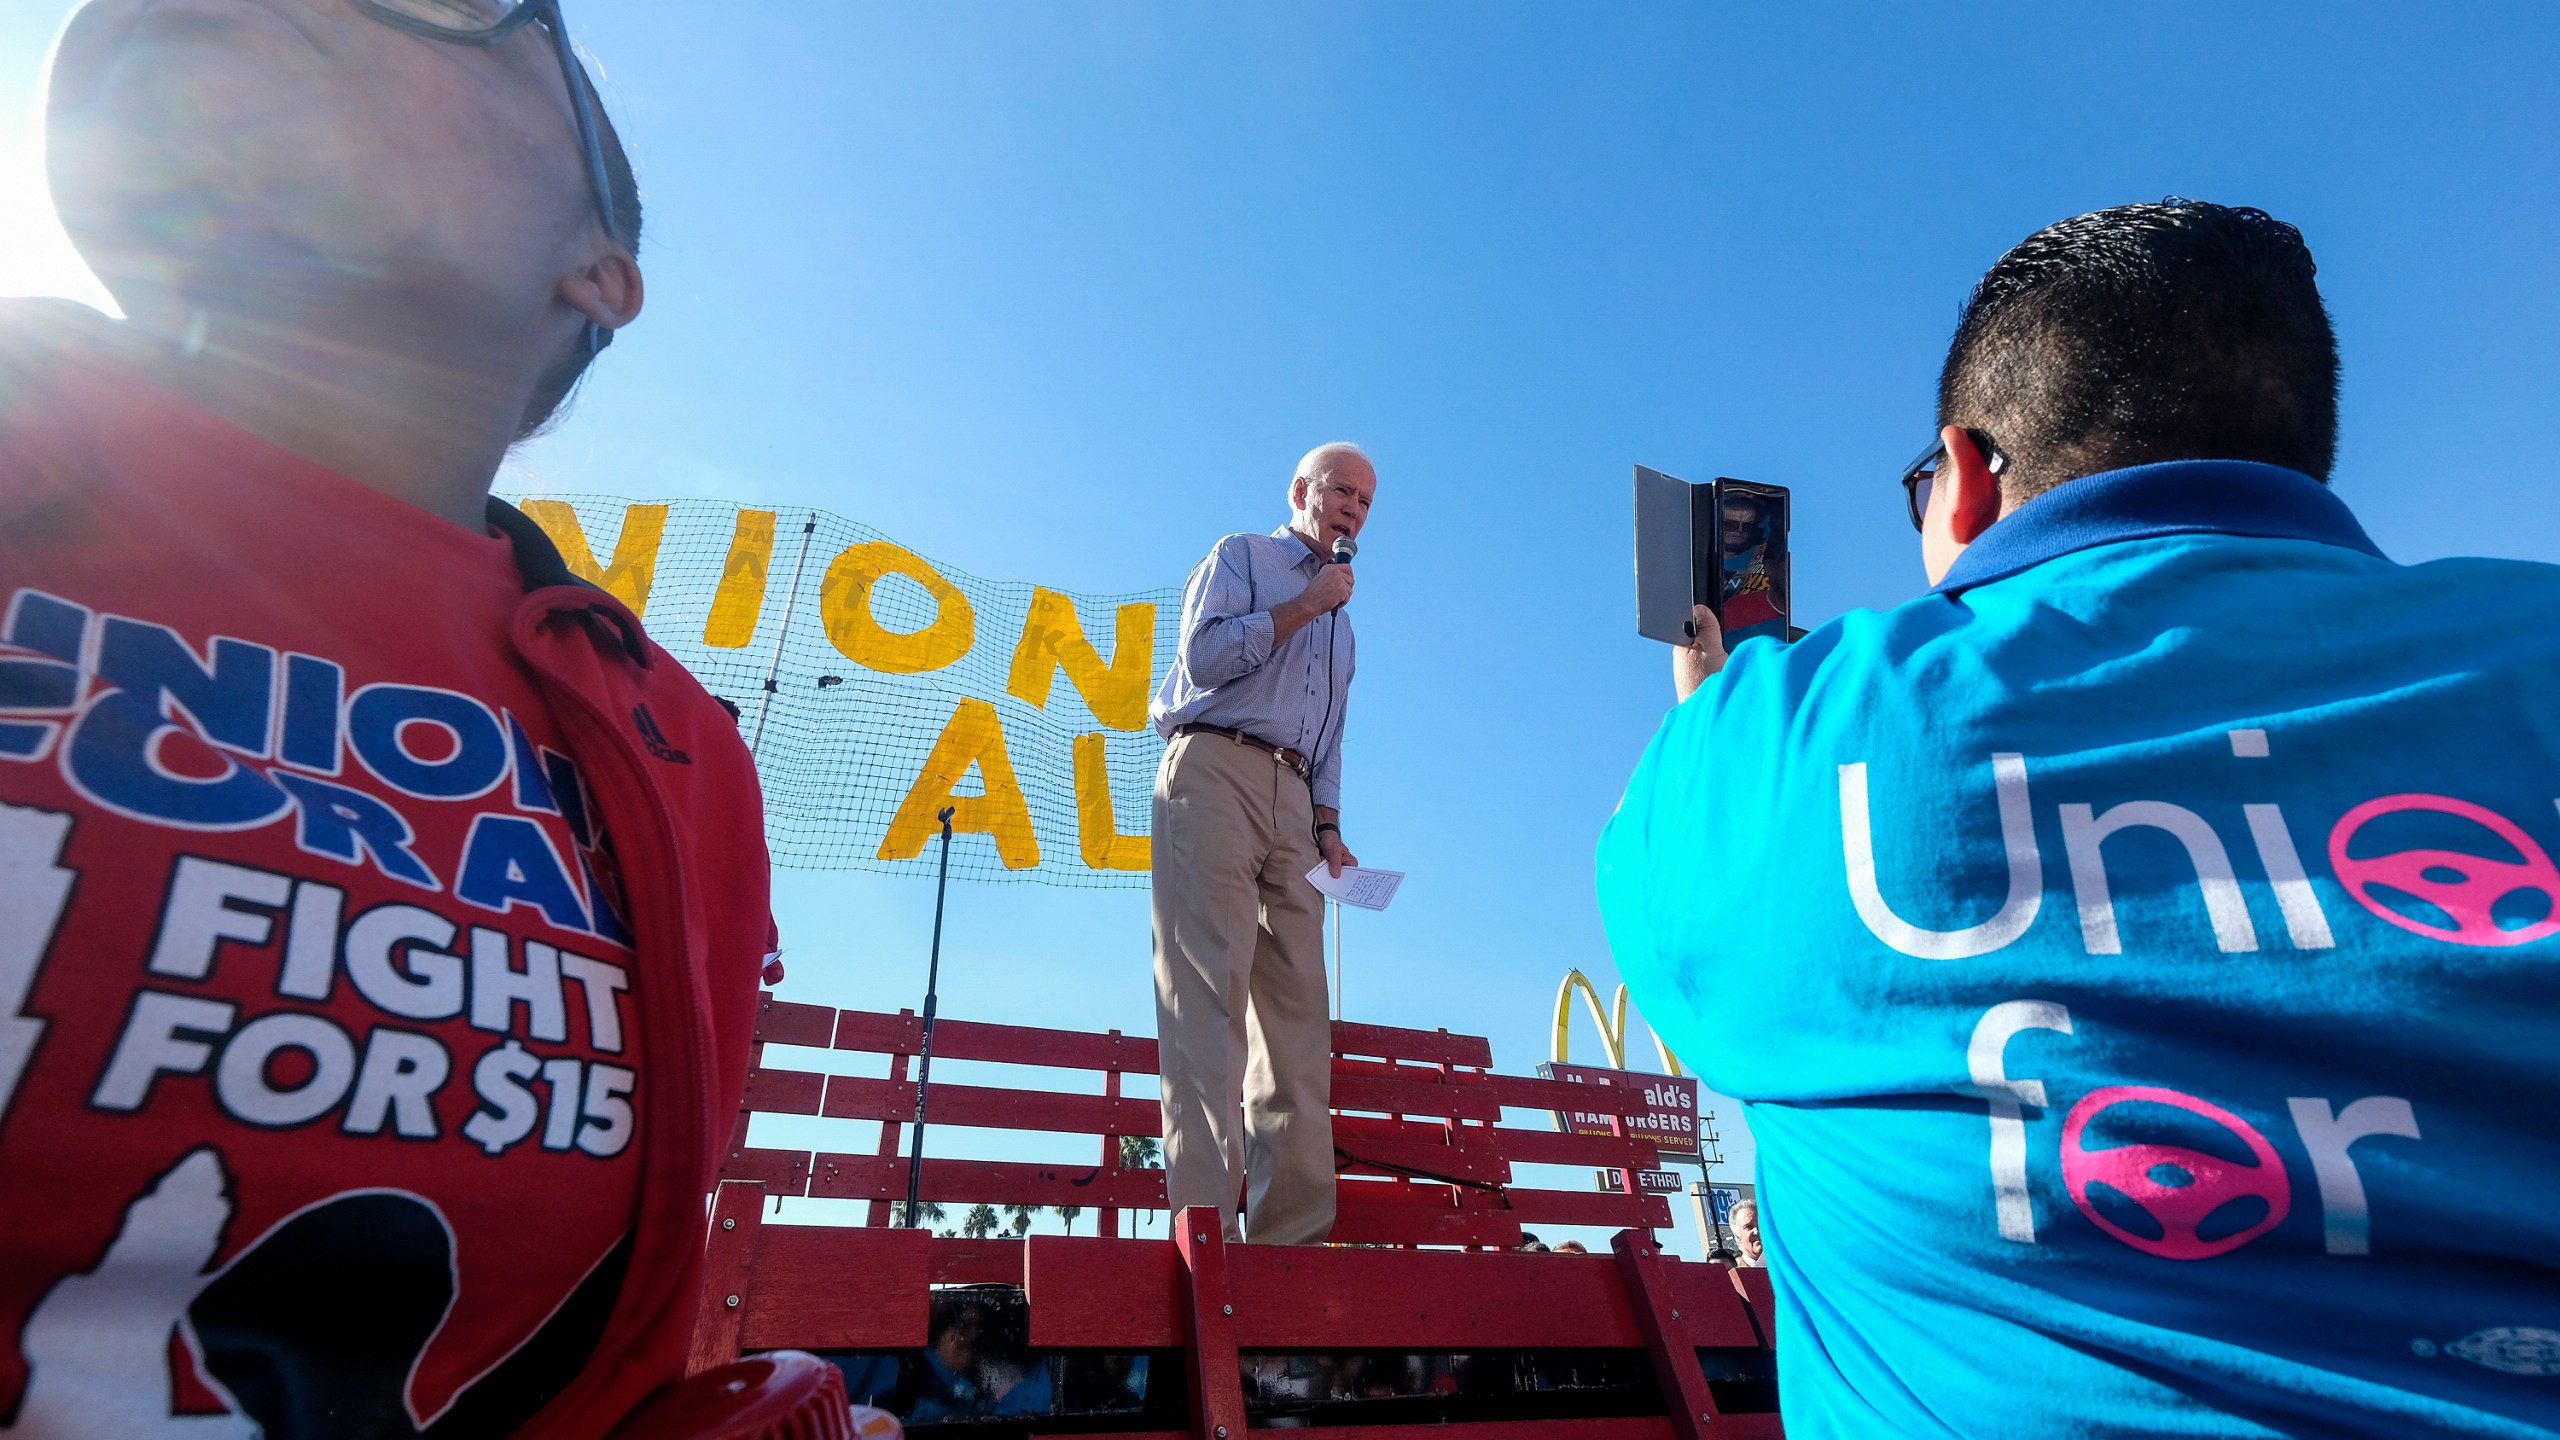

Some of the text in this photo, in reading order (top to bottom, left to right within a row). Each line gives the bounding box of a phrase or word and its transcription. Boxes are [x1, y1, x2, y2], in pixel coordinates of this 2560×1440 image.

[147, 853, 629, 1053] FIGHT
[91, 988, 636, 1156] FOR $15
[1575, 1111, 1692, 1132] HAMURGERS
[1664, 1135, 1694, 1146] SERVED
[1612, 1171, 1681, 1188] DE-THRU
